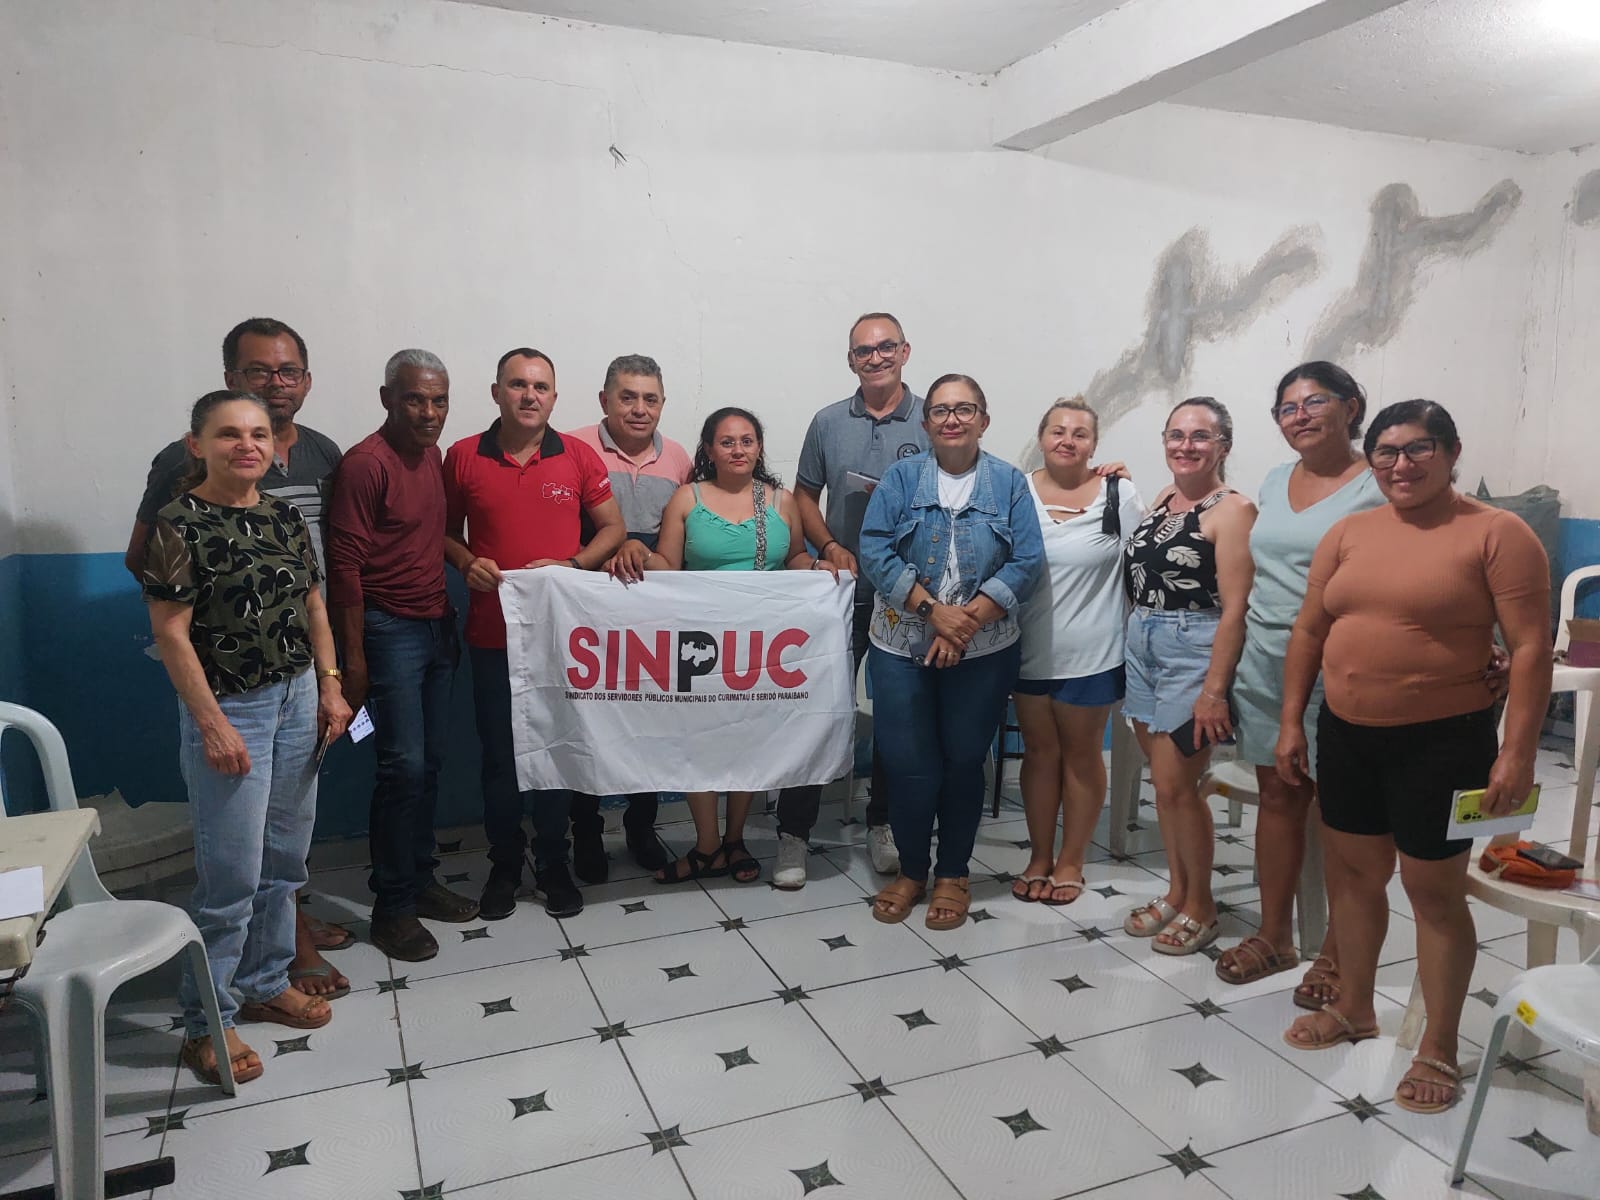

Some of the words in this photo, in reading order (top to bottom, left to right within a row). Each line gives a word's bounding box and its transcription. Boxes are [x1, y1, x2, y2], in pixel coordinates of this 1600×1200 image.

[567, 626, 810, 692] SINPUC
[565, 691, 593, 701] SINDICATO
[594, 692, 606, 701] DOS
[607, 692, 642, 702] SERVIDORES
[645, 692, 673, 703] PÚBLICOS
[675, 694, 707, 703] MUNICIPAIS
[708, 694, 716, 703] DO
[751, 693, 755, 701] E
[777, 691, 809, 700] PARAIBANO
